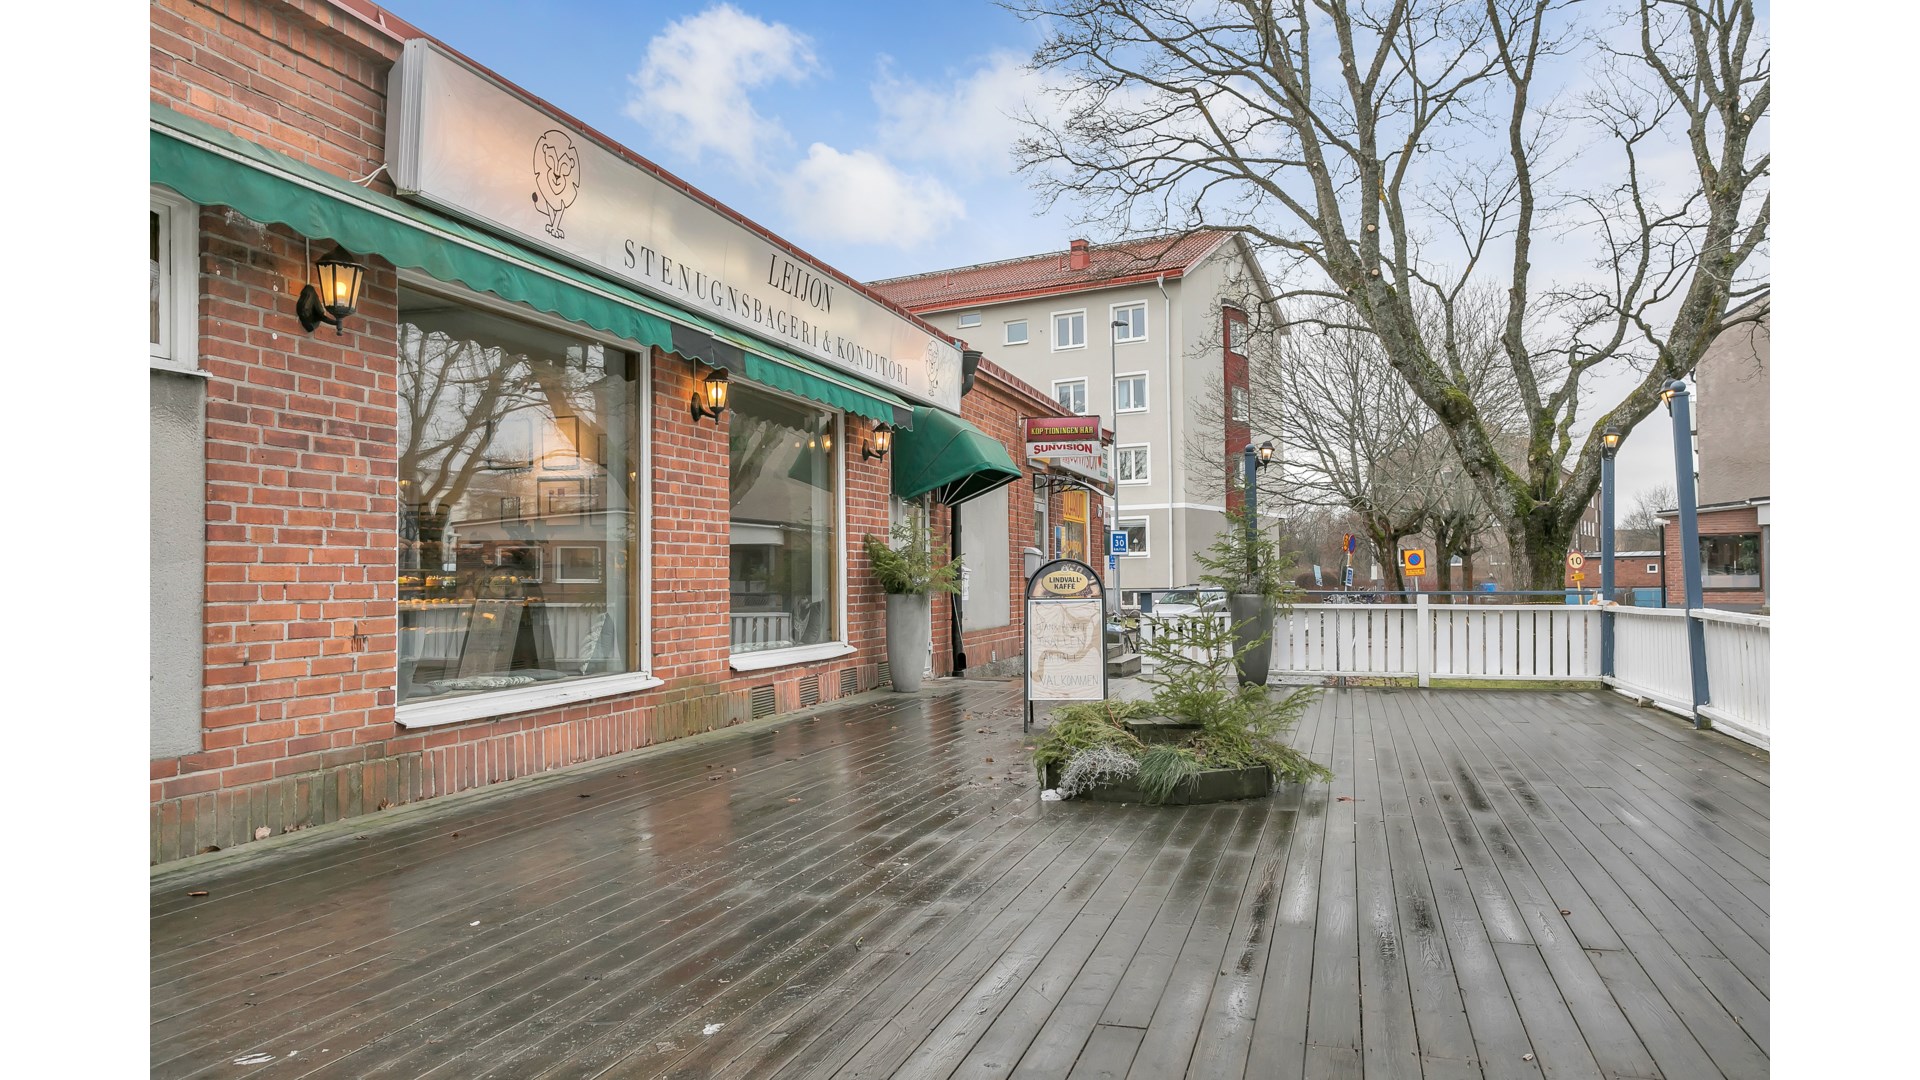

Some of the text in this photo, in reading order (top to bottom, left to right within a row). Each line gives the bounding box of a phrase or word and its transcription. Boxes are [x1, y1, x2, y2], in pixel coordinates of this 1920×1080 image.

[768, 253, 834, 315] LEIJON
[624, 238, 908, 386] STENUGNSBAGERI & KONDITORI
[1044, 426, 1079, 435] TIDNINGEN
[1033, 443, 1093, 455] SUNVISION
[1114, 539, 1125, 547] 30
[1570, 556, 1582, 566] 10
